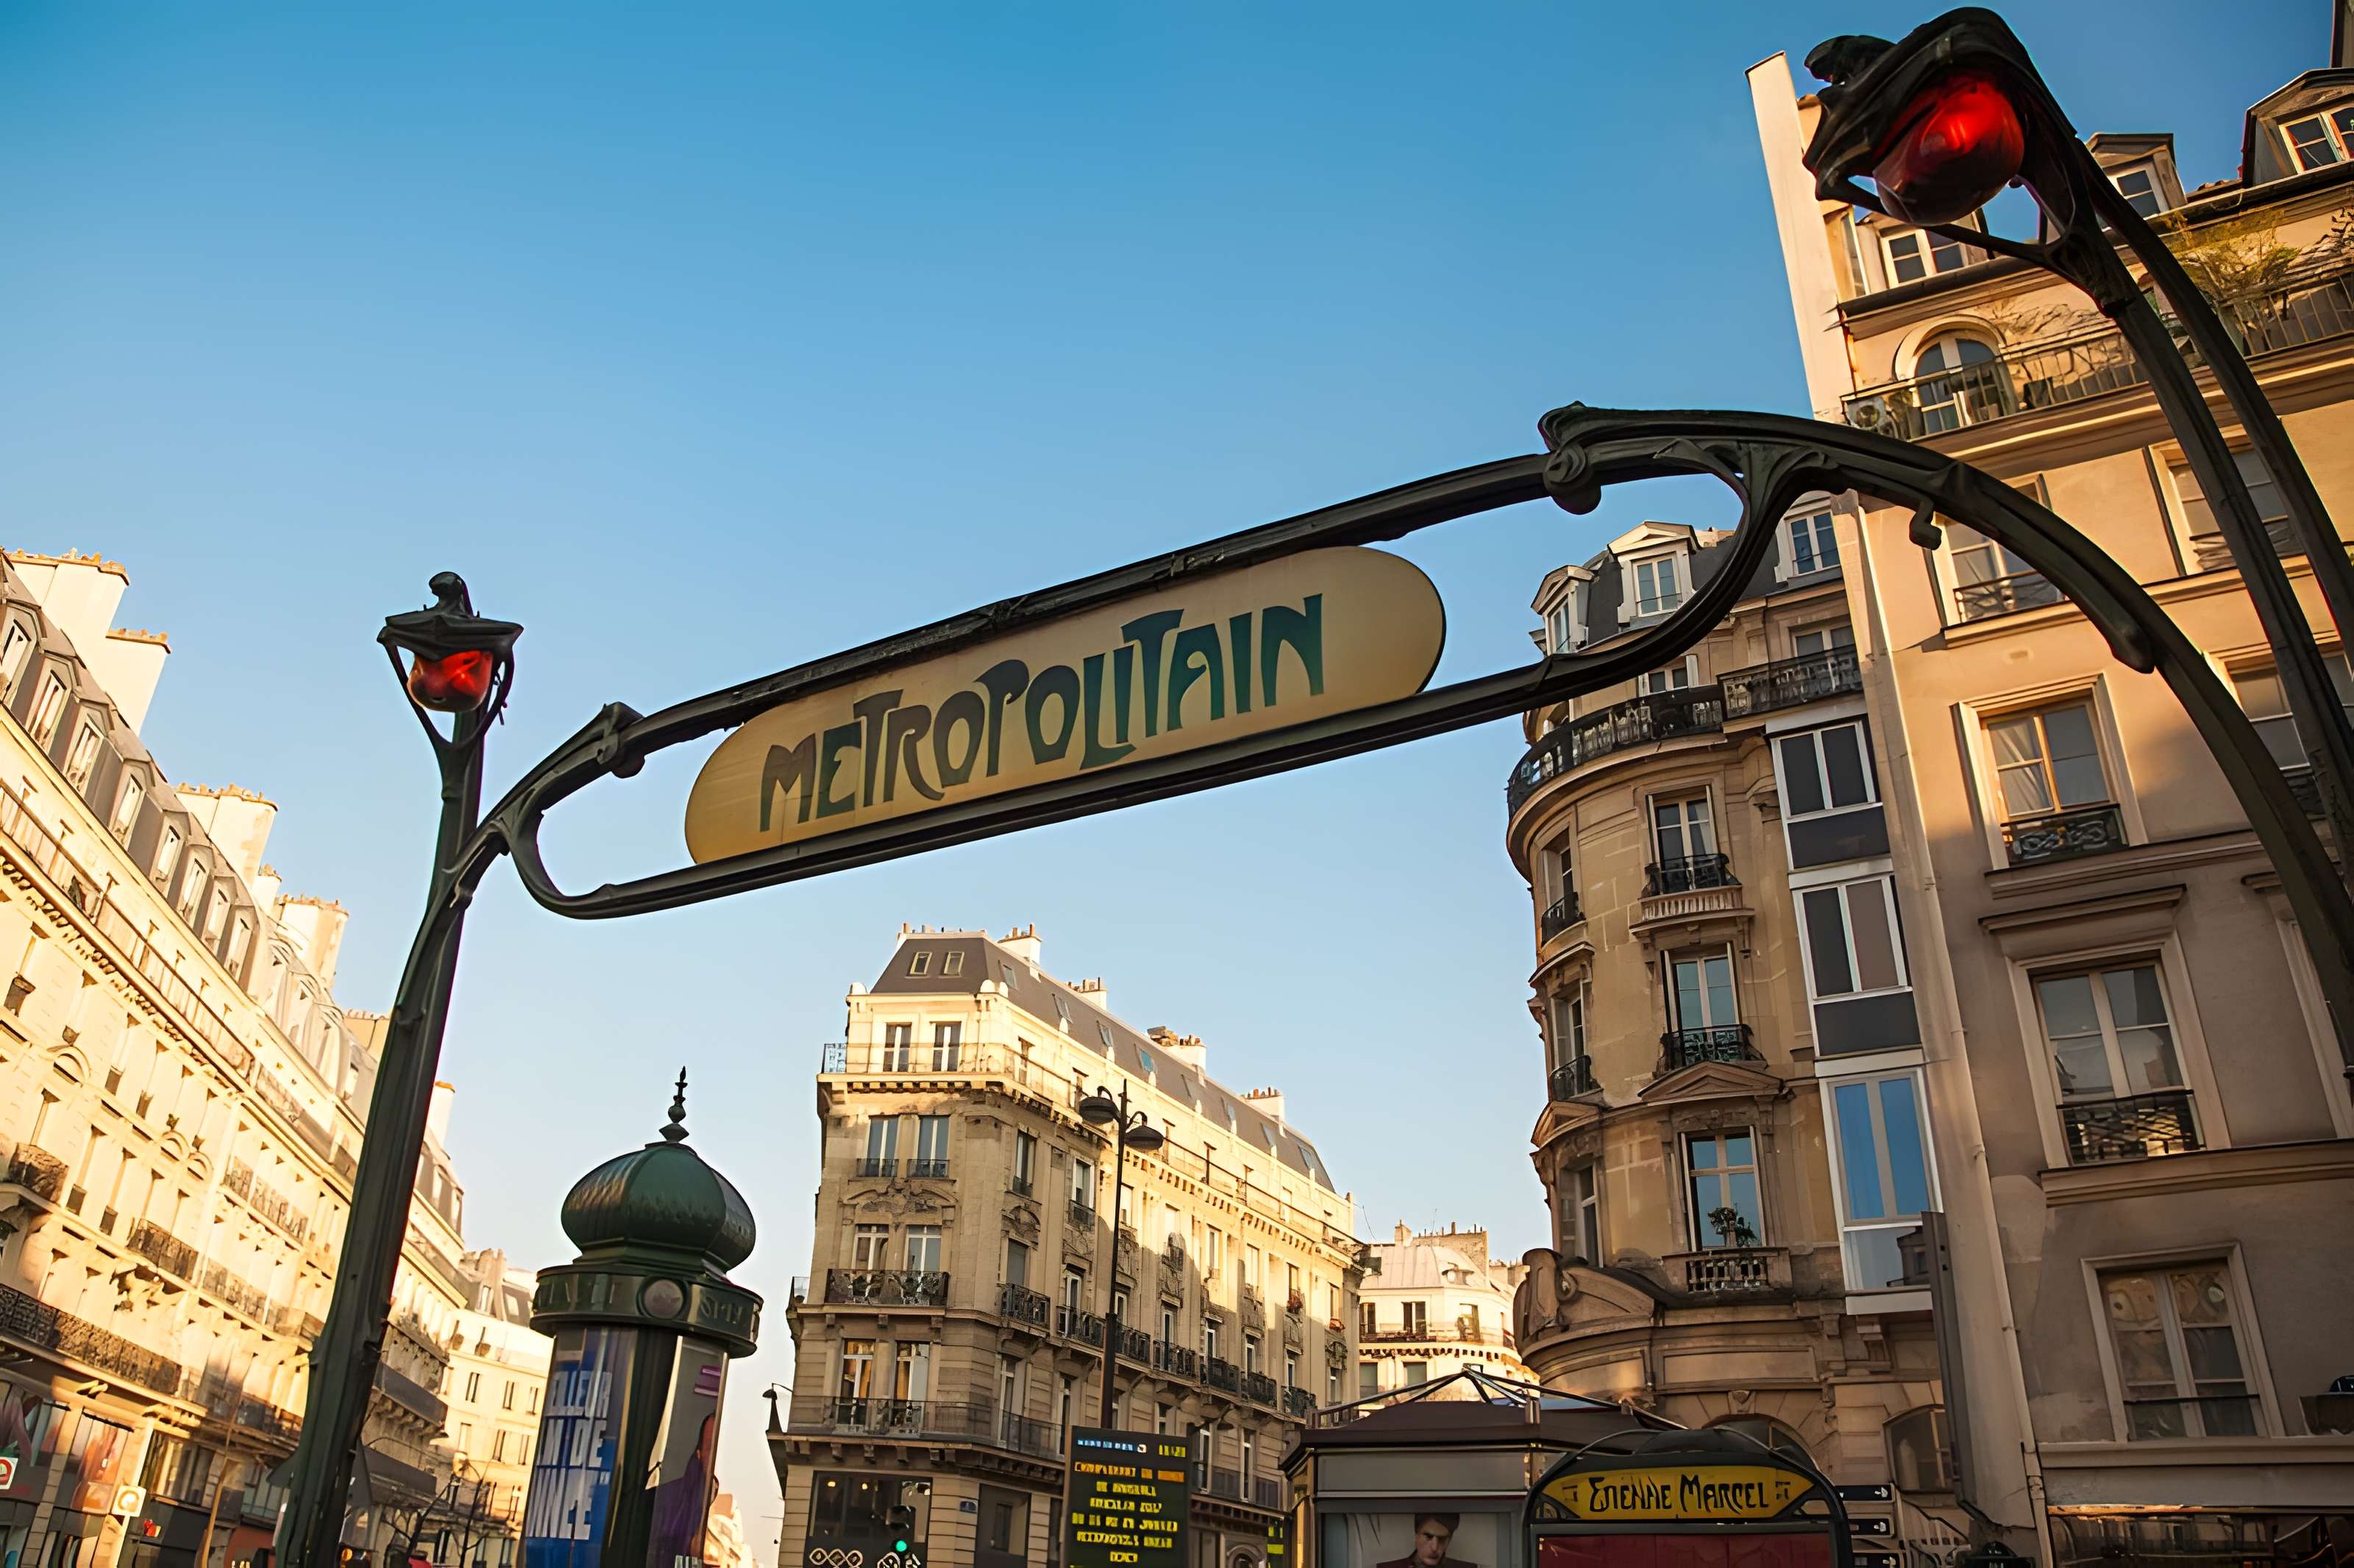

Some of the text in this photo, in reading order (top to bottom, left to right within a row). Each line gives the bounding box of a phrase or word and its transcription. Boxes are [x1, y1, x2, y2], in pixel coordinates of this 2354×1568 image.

[758, 593, 1323, 832] METROPOLITAIN
[1588, 1474, 1769, 1514] ETIENNE MARCEL
